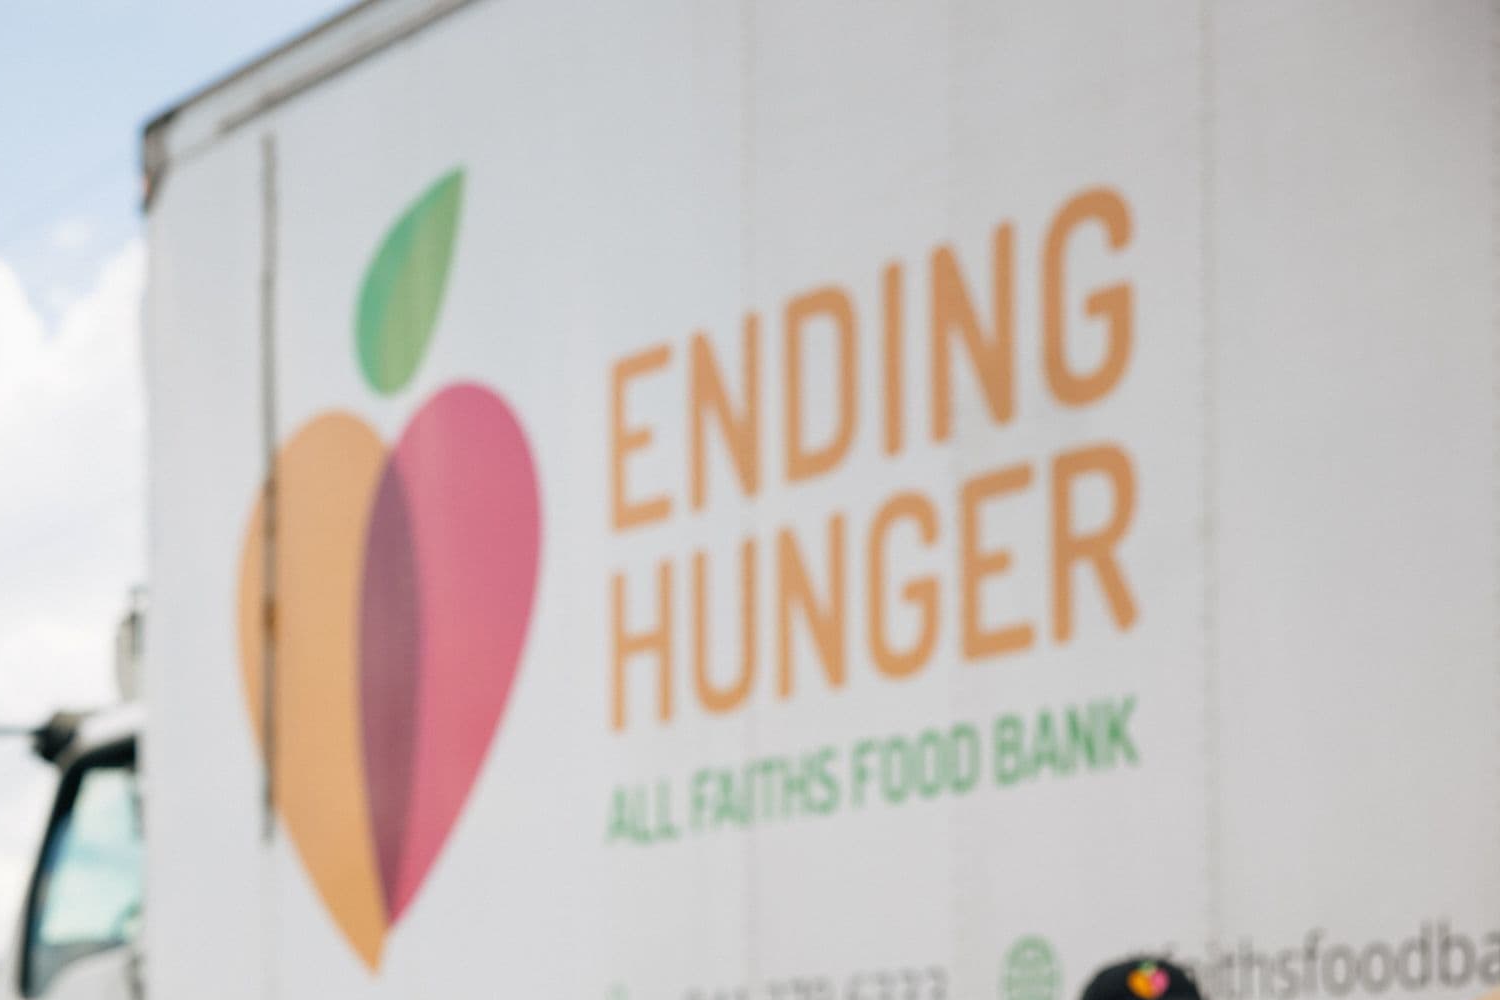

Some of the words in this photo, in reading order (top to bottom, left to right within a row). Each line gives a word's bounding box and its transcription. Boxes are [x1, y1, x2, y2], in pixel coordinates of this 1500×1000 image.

[610, 184, 1135, 533] ENDING
[610, 442, 1140, 733] HUNGER
[607, 777, 681, 844] ALL
[690, 746, 841, 831] FAITHS
[850, 721, 982, 806] FOOD
[993, 696, 1140, 788] BANK
